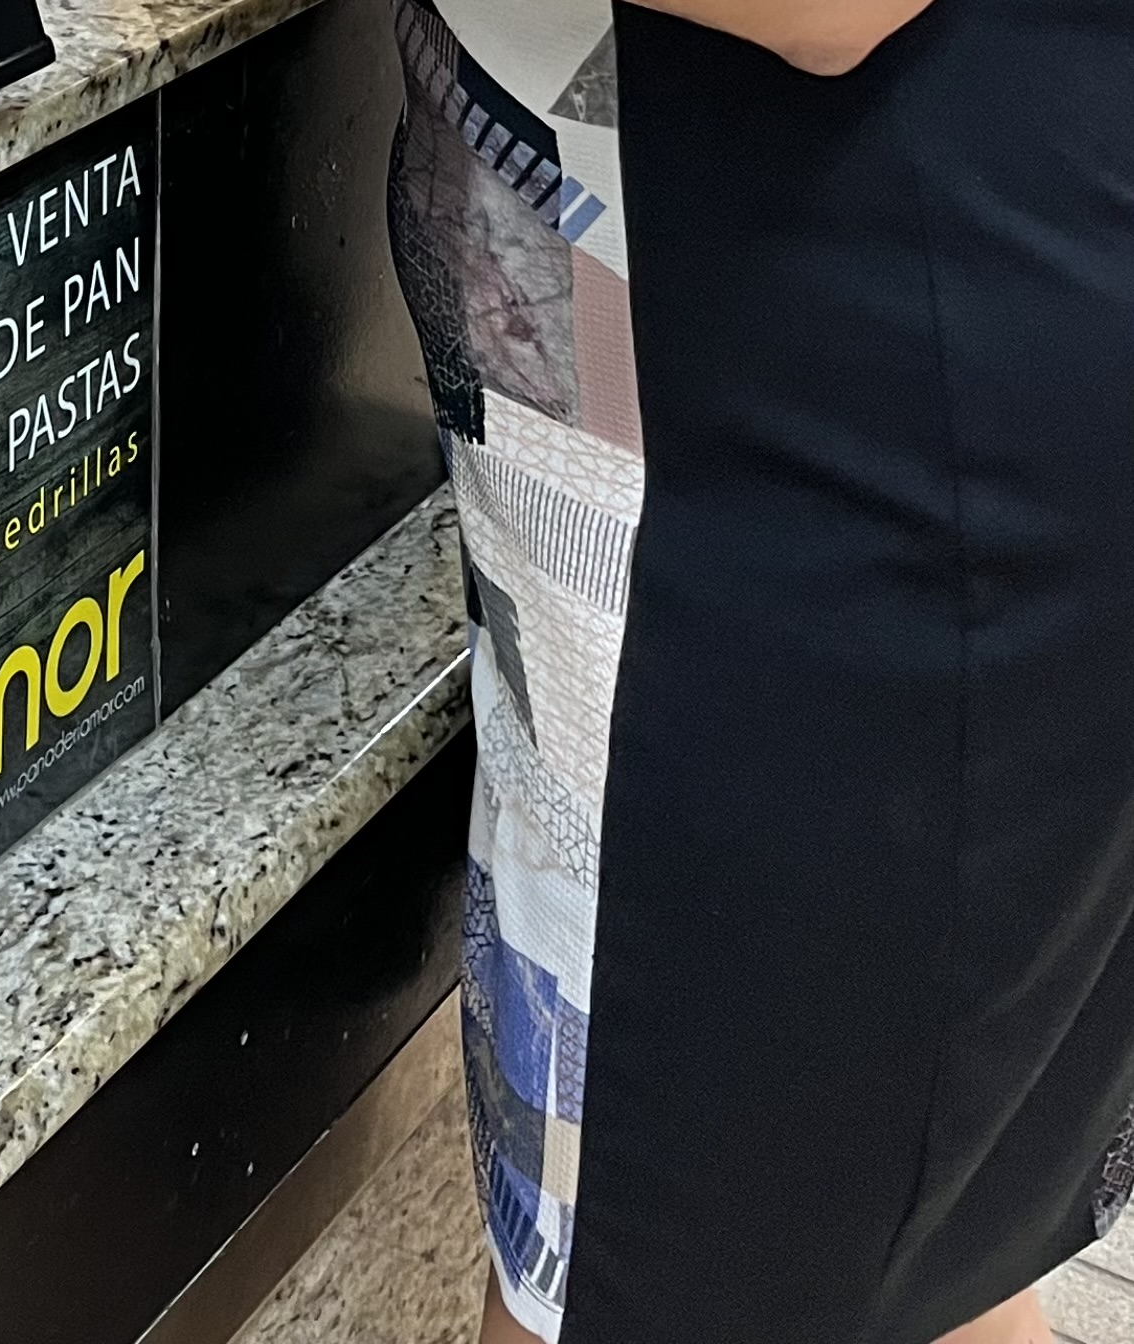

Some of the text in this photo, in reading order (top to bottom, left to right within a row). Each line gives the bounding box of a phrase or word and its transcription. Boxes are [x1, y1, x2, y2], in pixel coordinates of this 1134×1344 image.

[7, 145, 141, 267] VENTA
[64, 236, 140, 338] PAN
[8, 331, 141, 473] PASTAS
